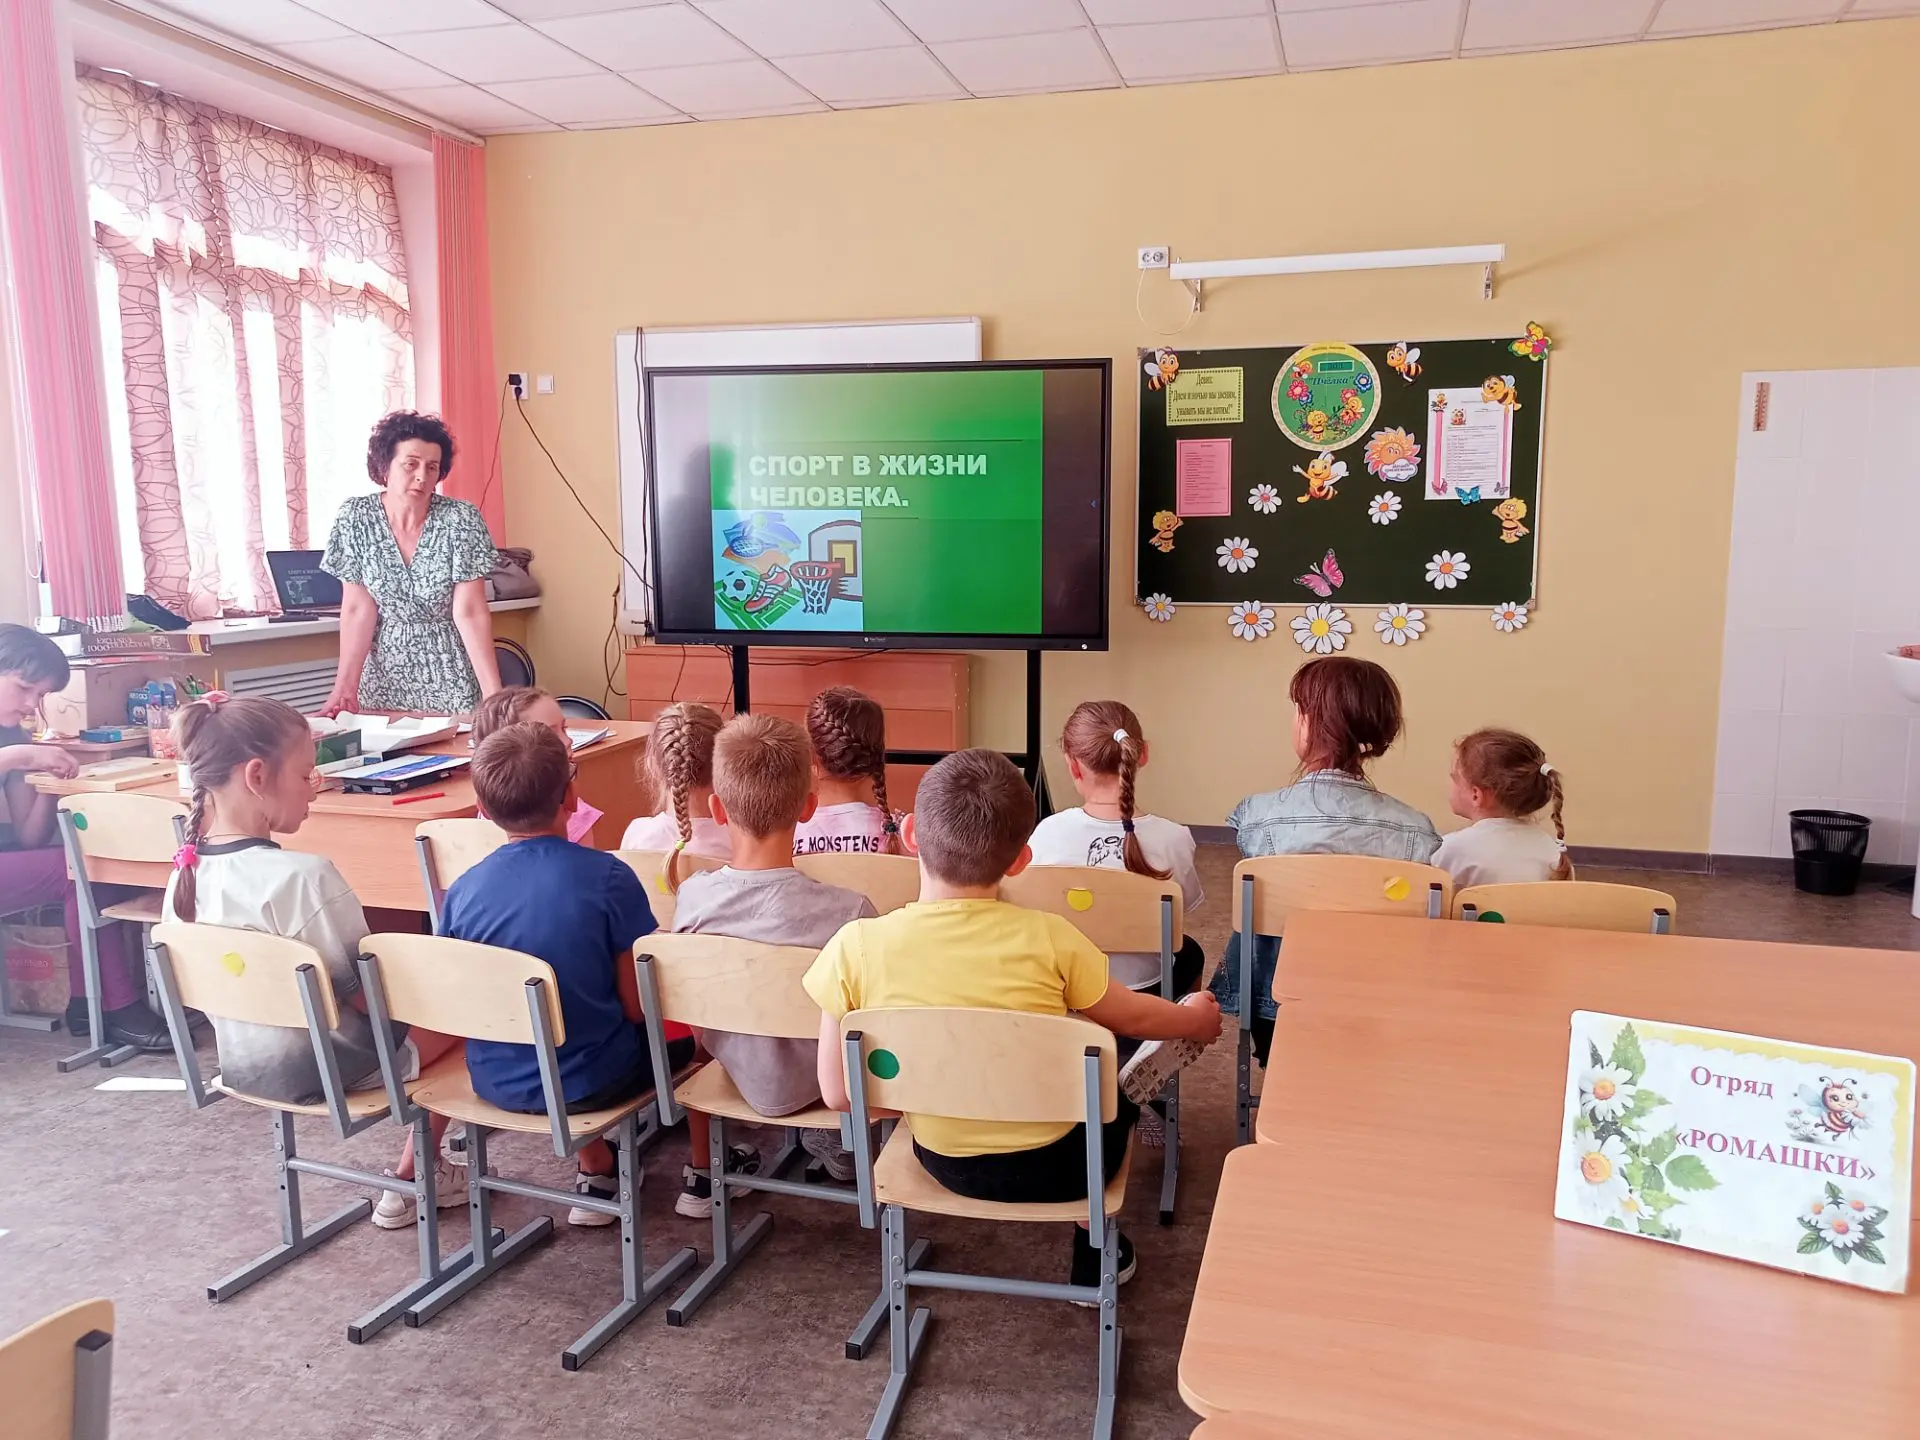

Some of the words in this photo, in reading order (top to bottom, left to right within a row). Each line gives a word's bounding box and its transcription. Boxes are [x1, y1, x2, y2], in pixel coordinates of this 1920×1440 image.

[749, 455, 843, 476] СПОРТ
[852, 455, 870, 476] В
[879, 454, 987, 476] ЖИЗНИ
[750, 486, 908, 507] ЧЕЛОВЕКА.
[1690, 1066, 1773, 1099] Отряд
[1675, 1128, 1876, 1181] «РОМАШКИ»
